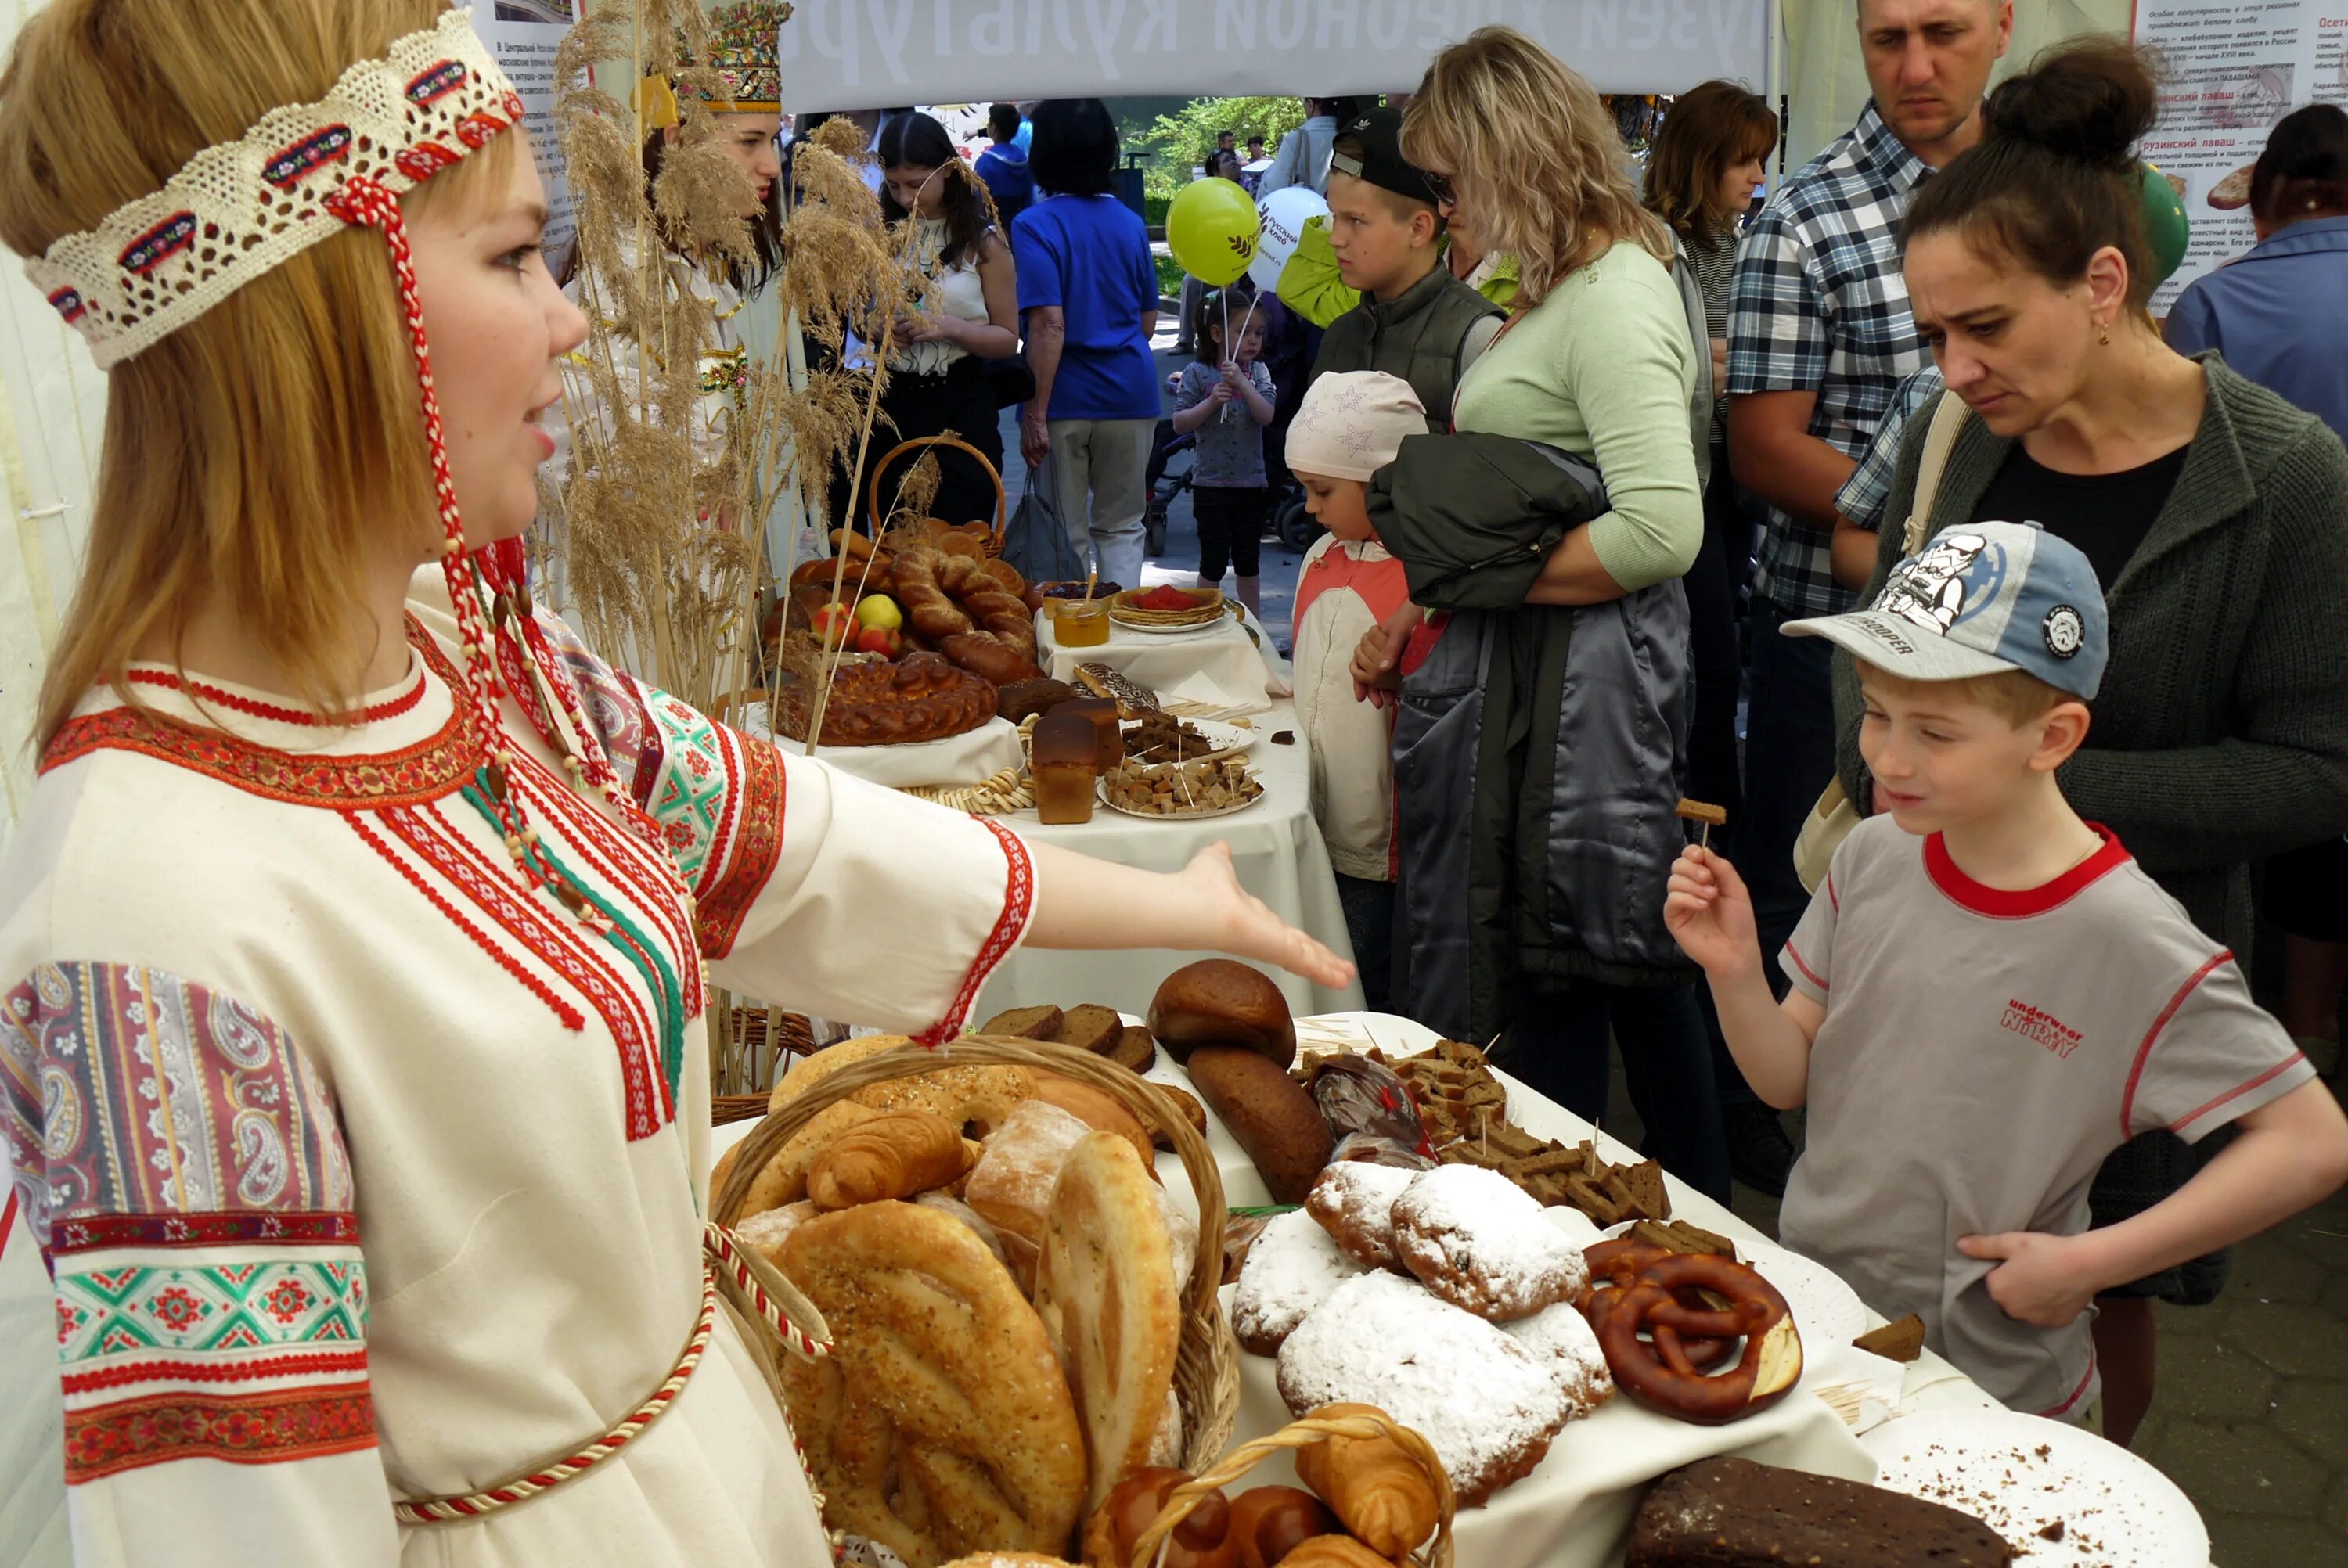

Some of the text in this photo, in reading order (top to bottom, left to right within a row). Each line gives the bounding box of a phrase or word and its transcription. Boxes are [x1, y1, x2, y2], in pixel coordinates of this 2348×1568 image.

[2201, 92, 2234, 100] лаваш
[2202, 138, 2235, 147] лаваш
[1268, 217, 1298, 245] Русский
[1268, 228, 1288, 246] хлеб
[2009, 998, 2083, 1041] underwear
